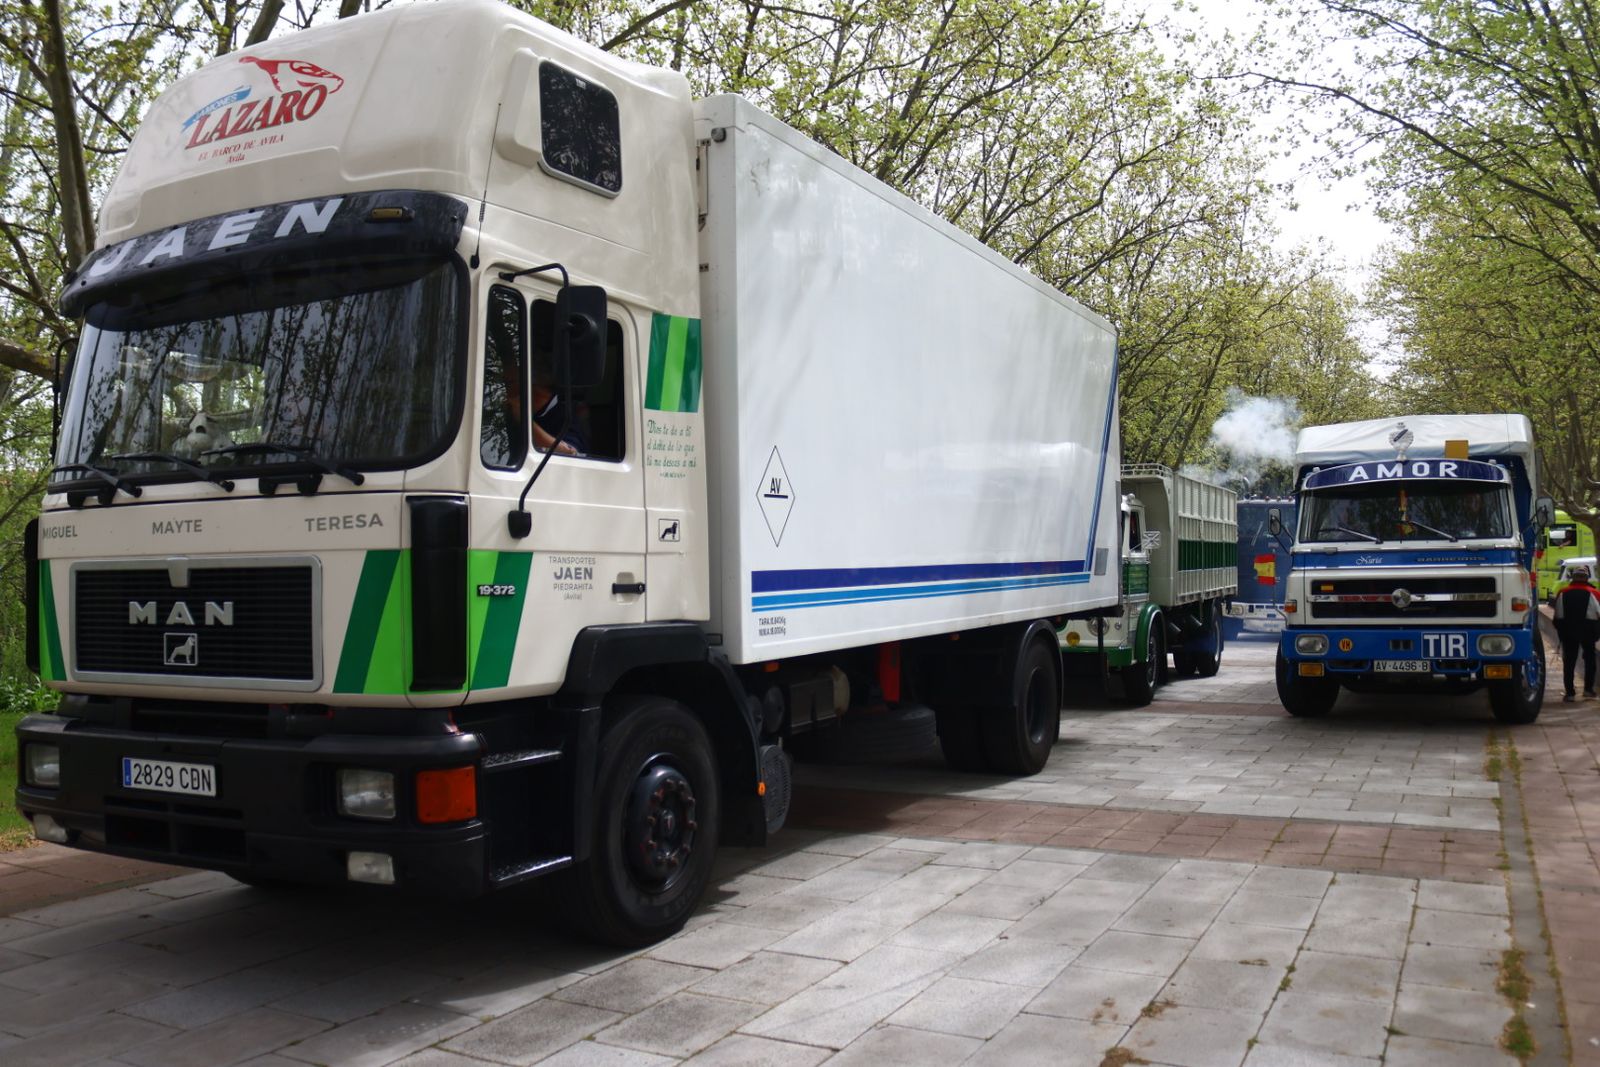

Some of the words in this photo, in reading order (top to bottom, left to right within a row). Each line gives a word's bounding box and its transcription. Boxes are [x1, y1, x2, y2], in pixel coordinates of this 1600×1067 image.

[185, 85, 327, 149] LAZARO
[212, 144, 240, 158] BARCO
[90, 198, 343, 277] JAEN
[1348, 461, 1459, 482] AMOR
[770, 477, 781, 494] AV
[152, 520, 203, 534] MAYTE
[305, 513, 383, 532] TERESA
[42, 525, 78, 539] MIGUEL
[549, 556, 596, 565] TRANSPORTES
[554, 567, 593, 580] JAEN
[553, 583, 593, 591] PIEDRAHITA
[128, 601, 234, 626] MAN
[1423, 634, 1465, 658] TIR
[133, 763, 174, 788] 2829
[179, 767, 212, 792] CDN
